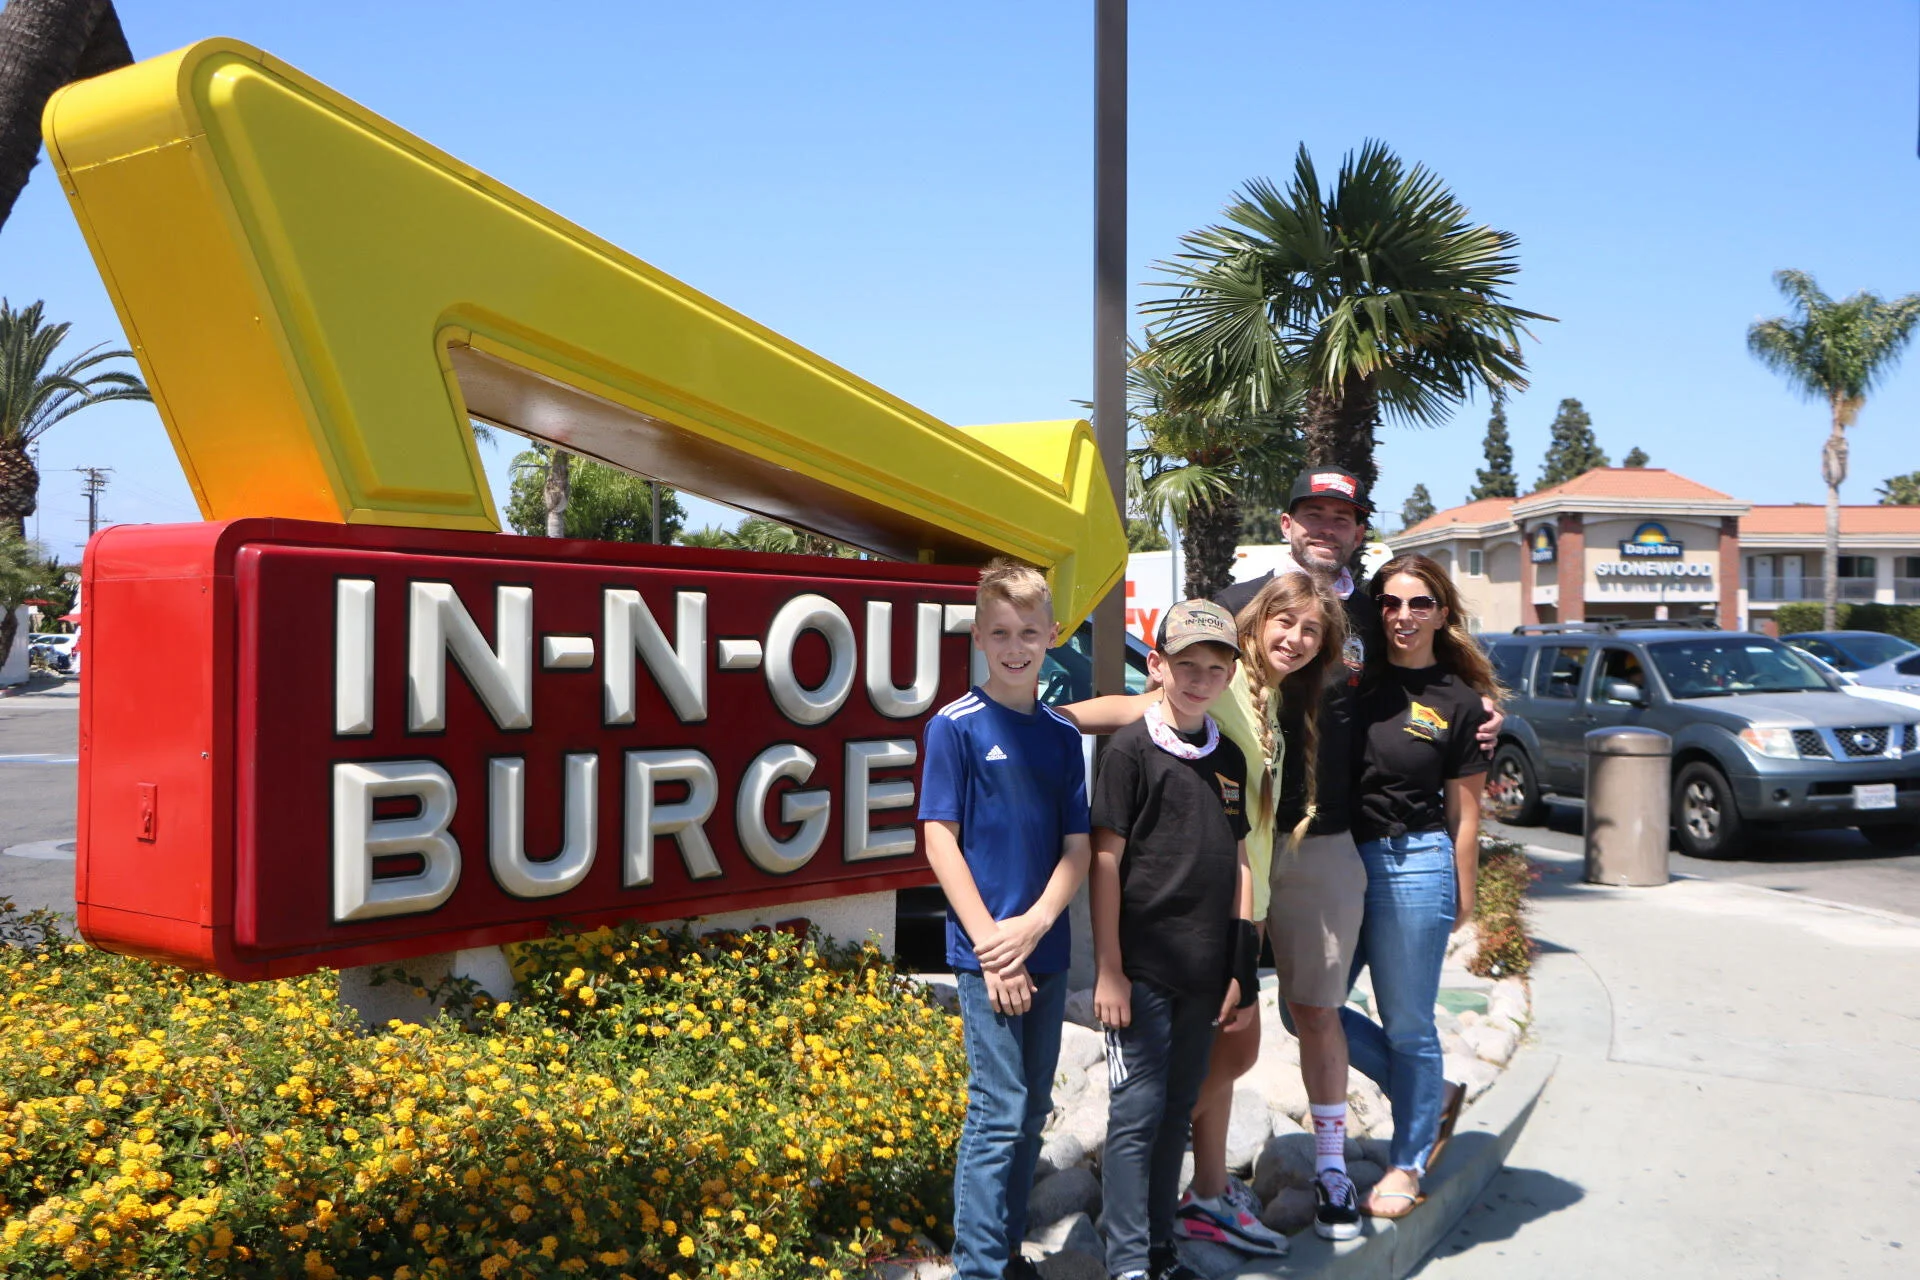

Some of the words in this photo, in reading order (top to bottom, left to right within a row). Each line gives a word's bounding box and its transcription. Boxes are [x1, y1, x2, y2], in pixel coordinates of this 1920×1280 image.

[1624, 544, 1656, 555] Days
[1657, 545, 1679, 554] Inn
[1595, 561, 1713, 575] STONEWOOD
